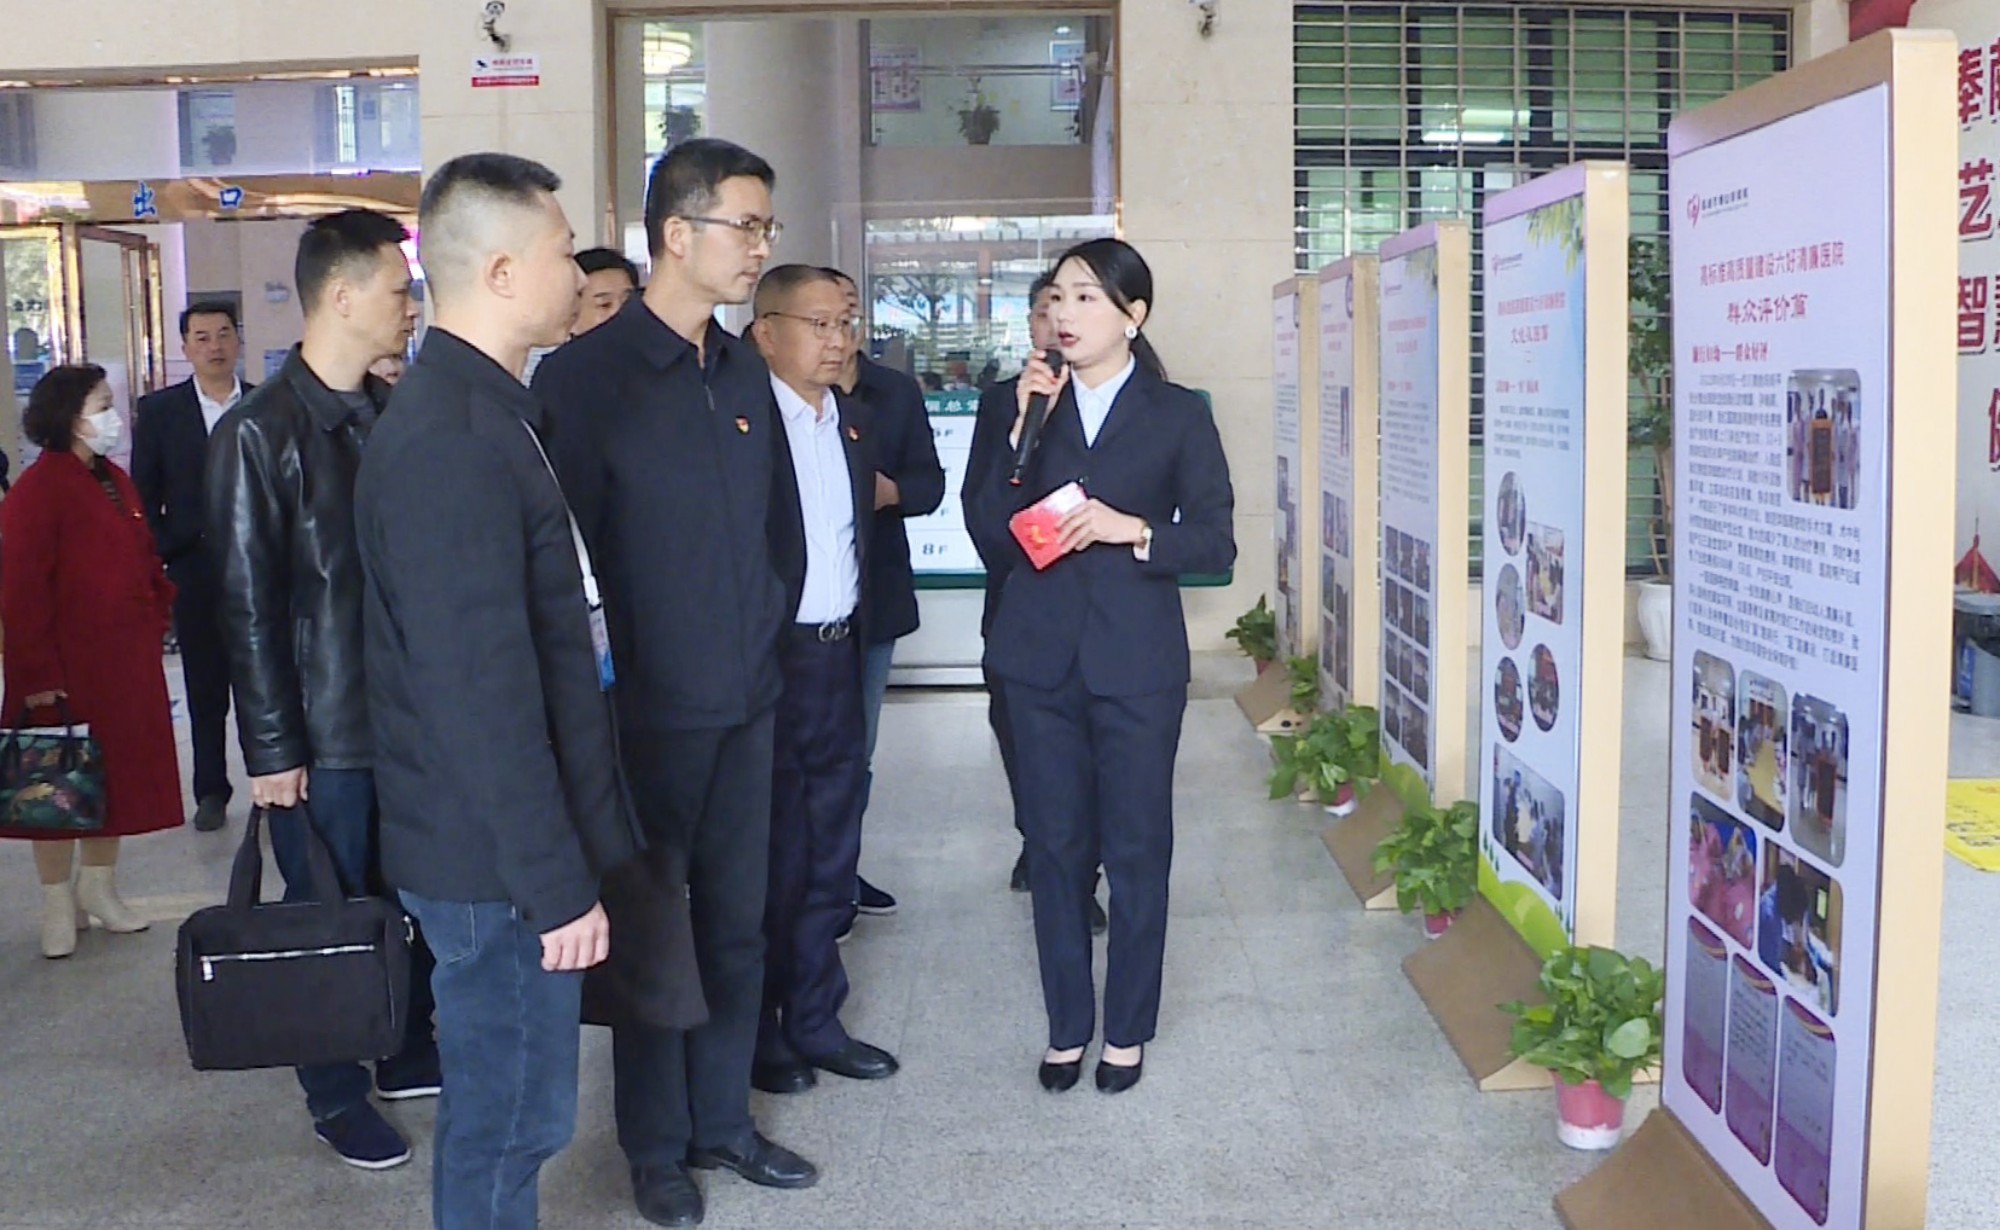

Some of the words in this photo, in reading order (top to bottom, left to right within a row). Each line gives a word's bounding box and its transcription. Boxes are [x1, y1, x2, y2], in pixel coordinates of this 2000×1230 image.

[133, 180, 242, 218] 出口
[1727, 293, 1808, 324] 群众评价篇
[1958, 274, 2000, 349] 智
[922, 544, 948, 555] 8F
